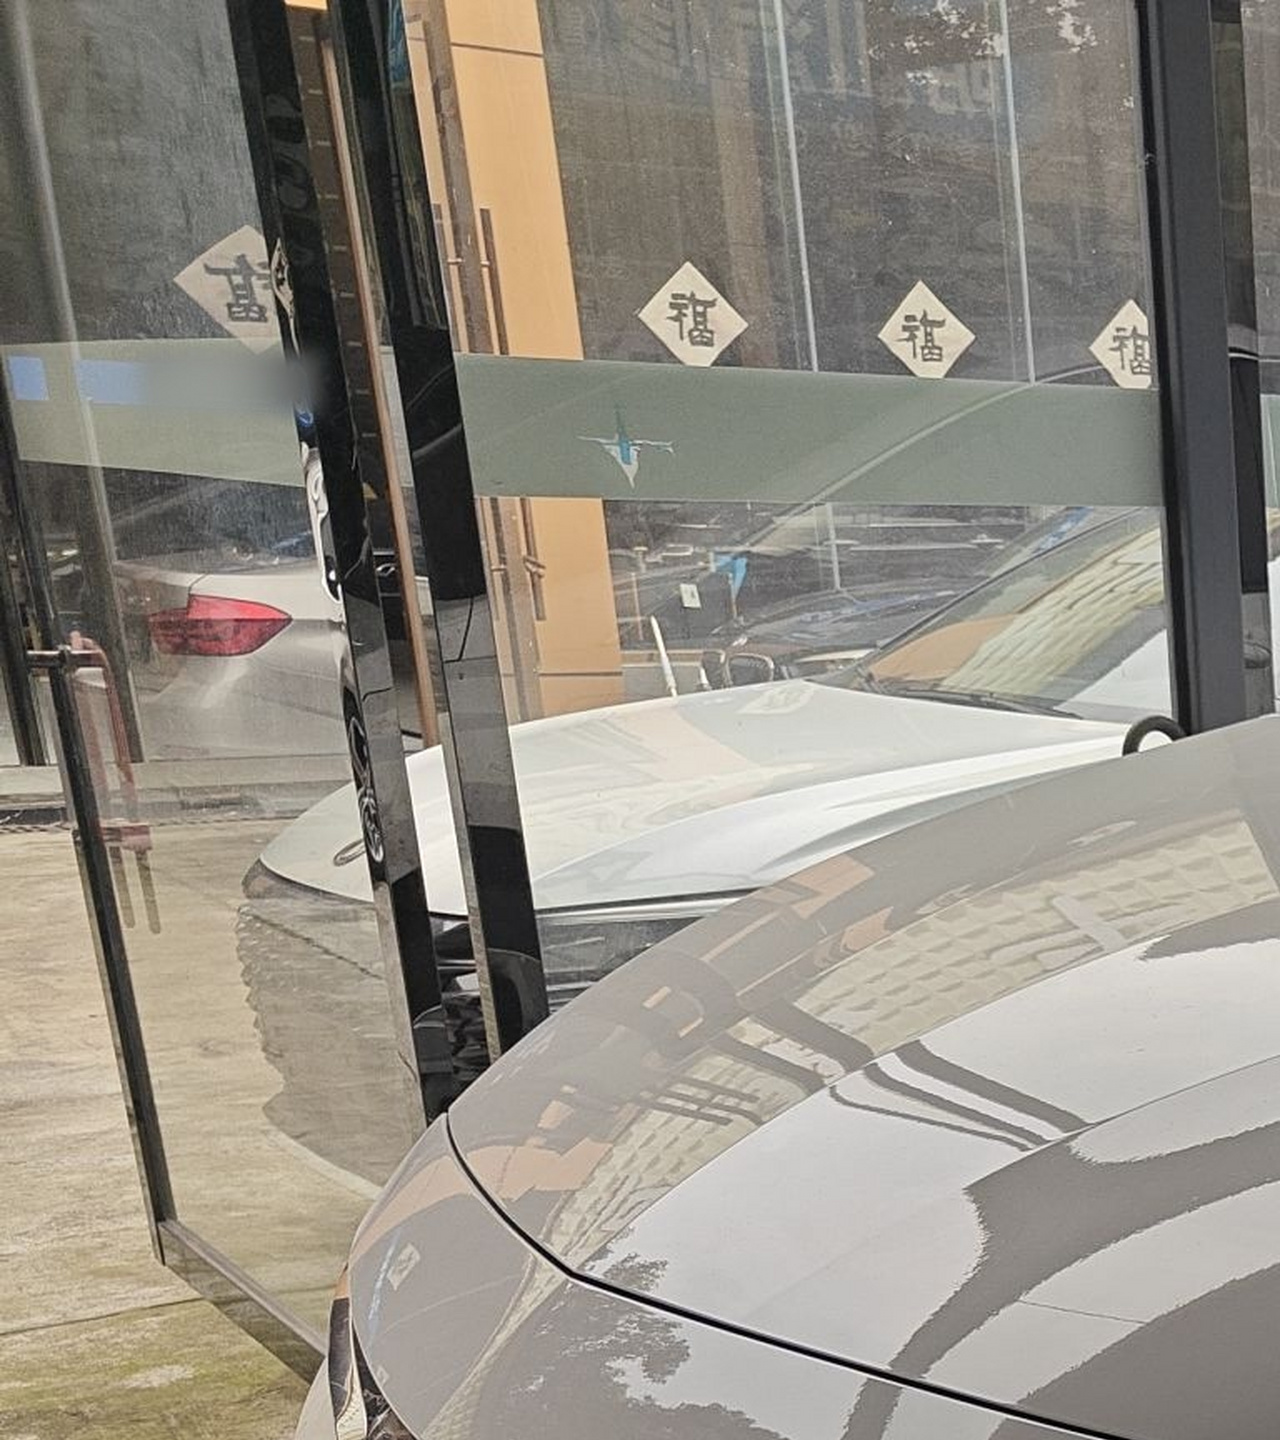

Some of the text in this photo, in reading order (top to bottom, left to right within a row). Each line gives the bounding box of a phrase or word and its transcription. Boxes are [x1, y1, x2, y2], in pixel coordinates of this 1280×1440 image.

[666, 291, 718, 347] 福
[896, 309, 946, 362] 福
[1108, 325, 1151, 375] 福
